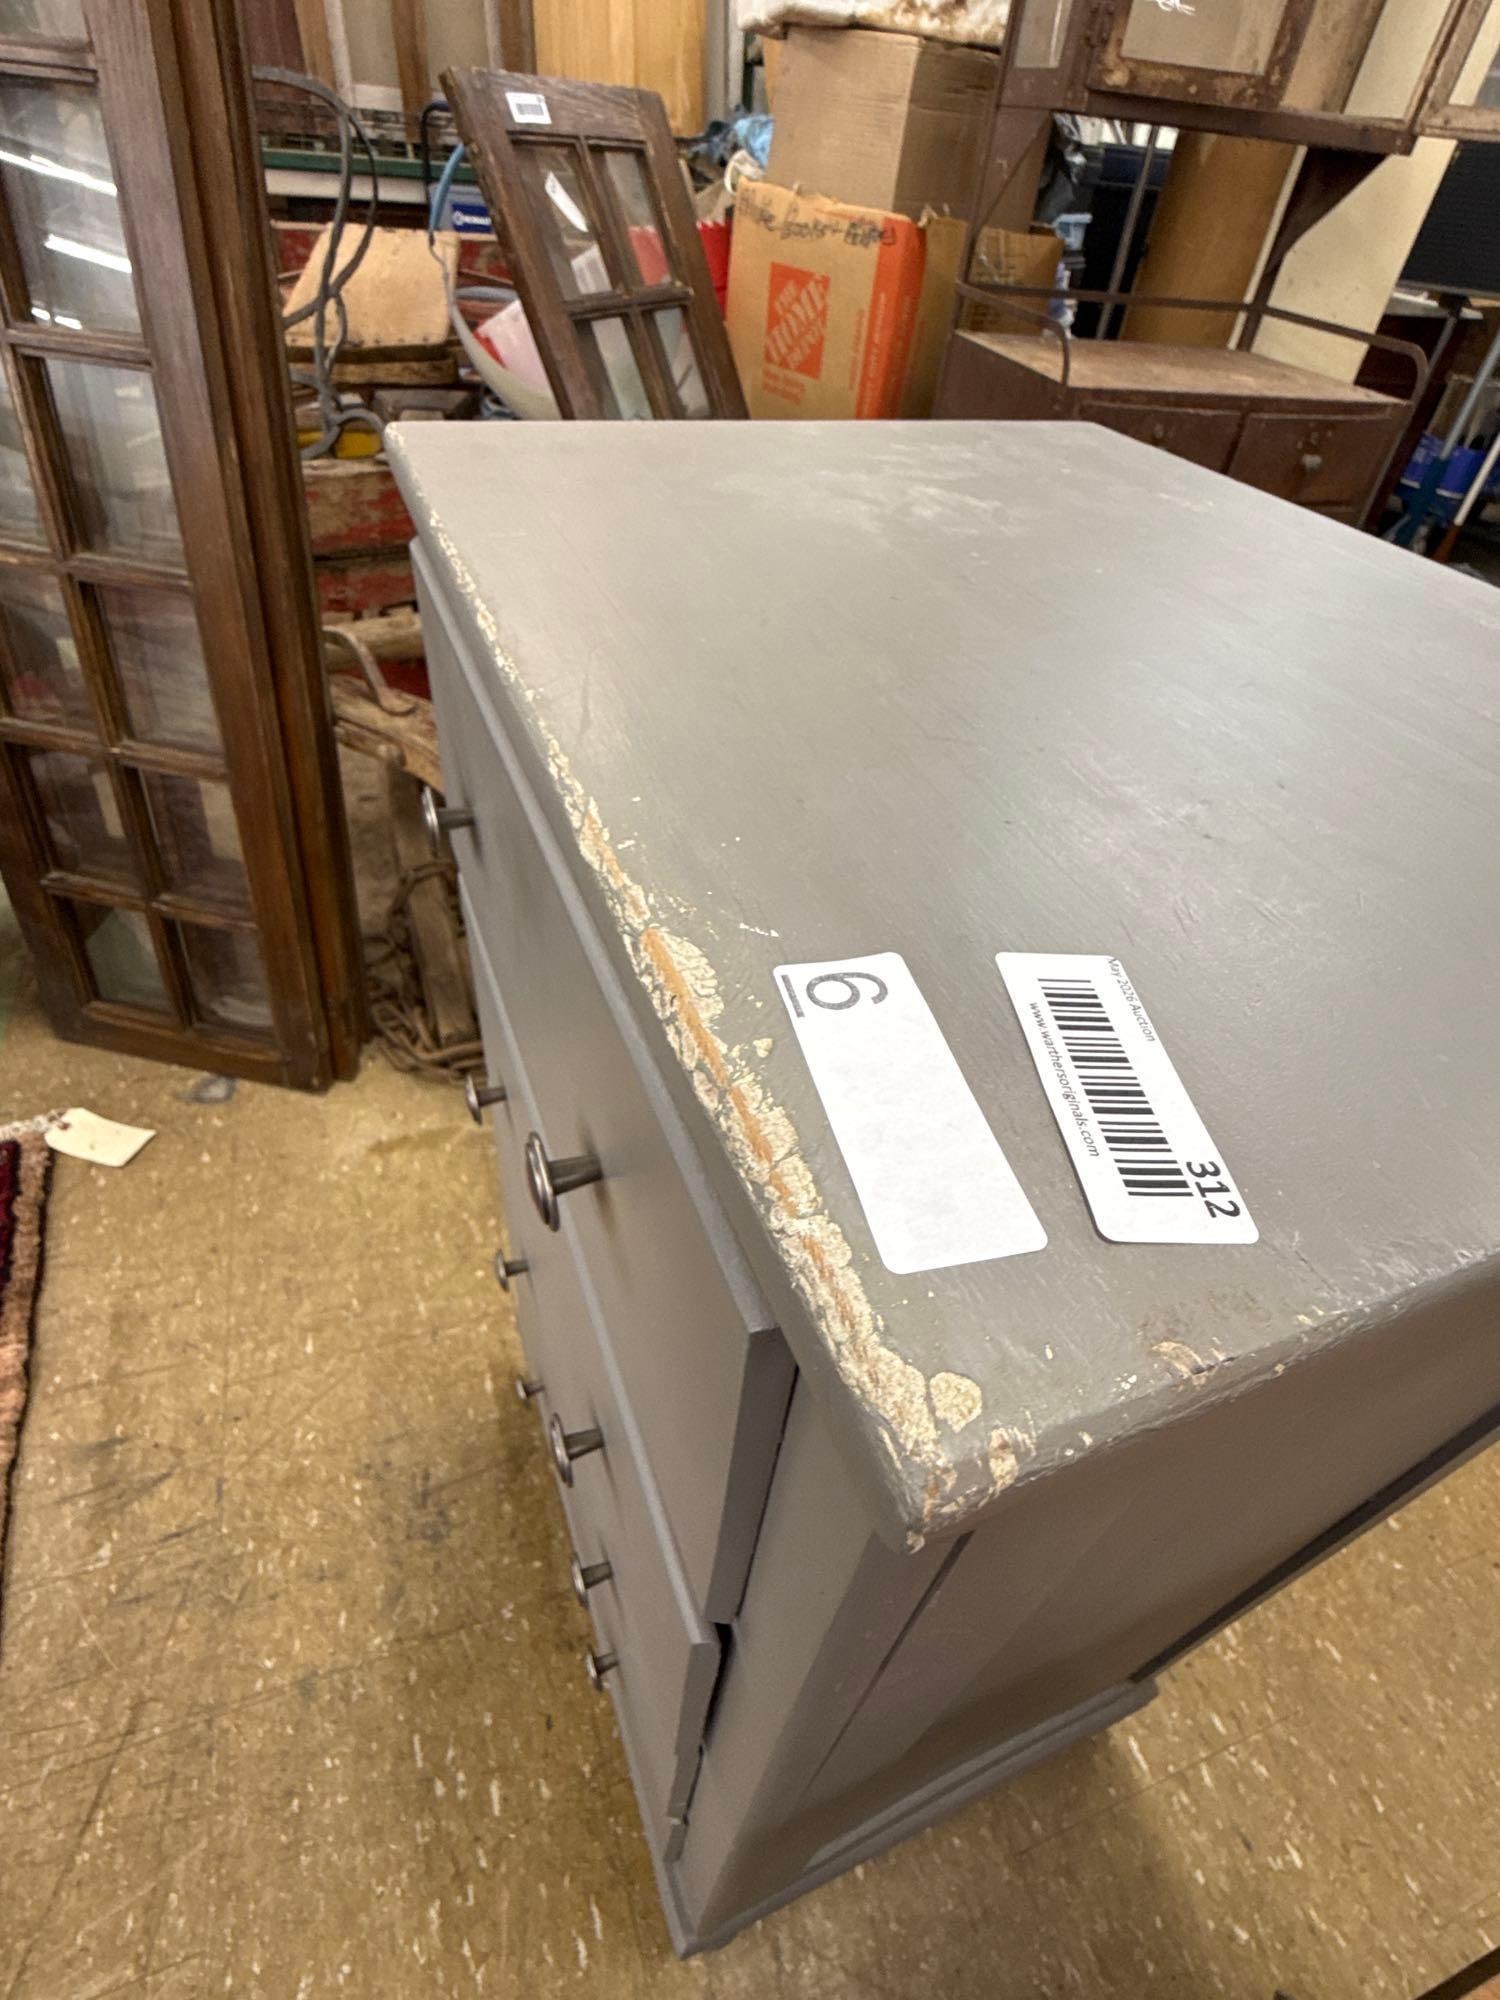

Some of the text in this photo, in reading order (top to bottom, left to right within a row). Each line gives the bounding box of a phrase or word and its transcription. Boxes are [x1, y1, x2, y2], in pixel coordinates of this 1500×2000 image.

[1116, 978, 1138, 1002] 2026
[1129, 1003, 1156, 1042] Auction
[1029, 1001, 1099, 1158] www.warthersoriginals.com
[1186, 1160, 1241, 1219] 312
